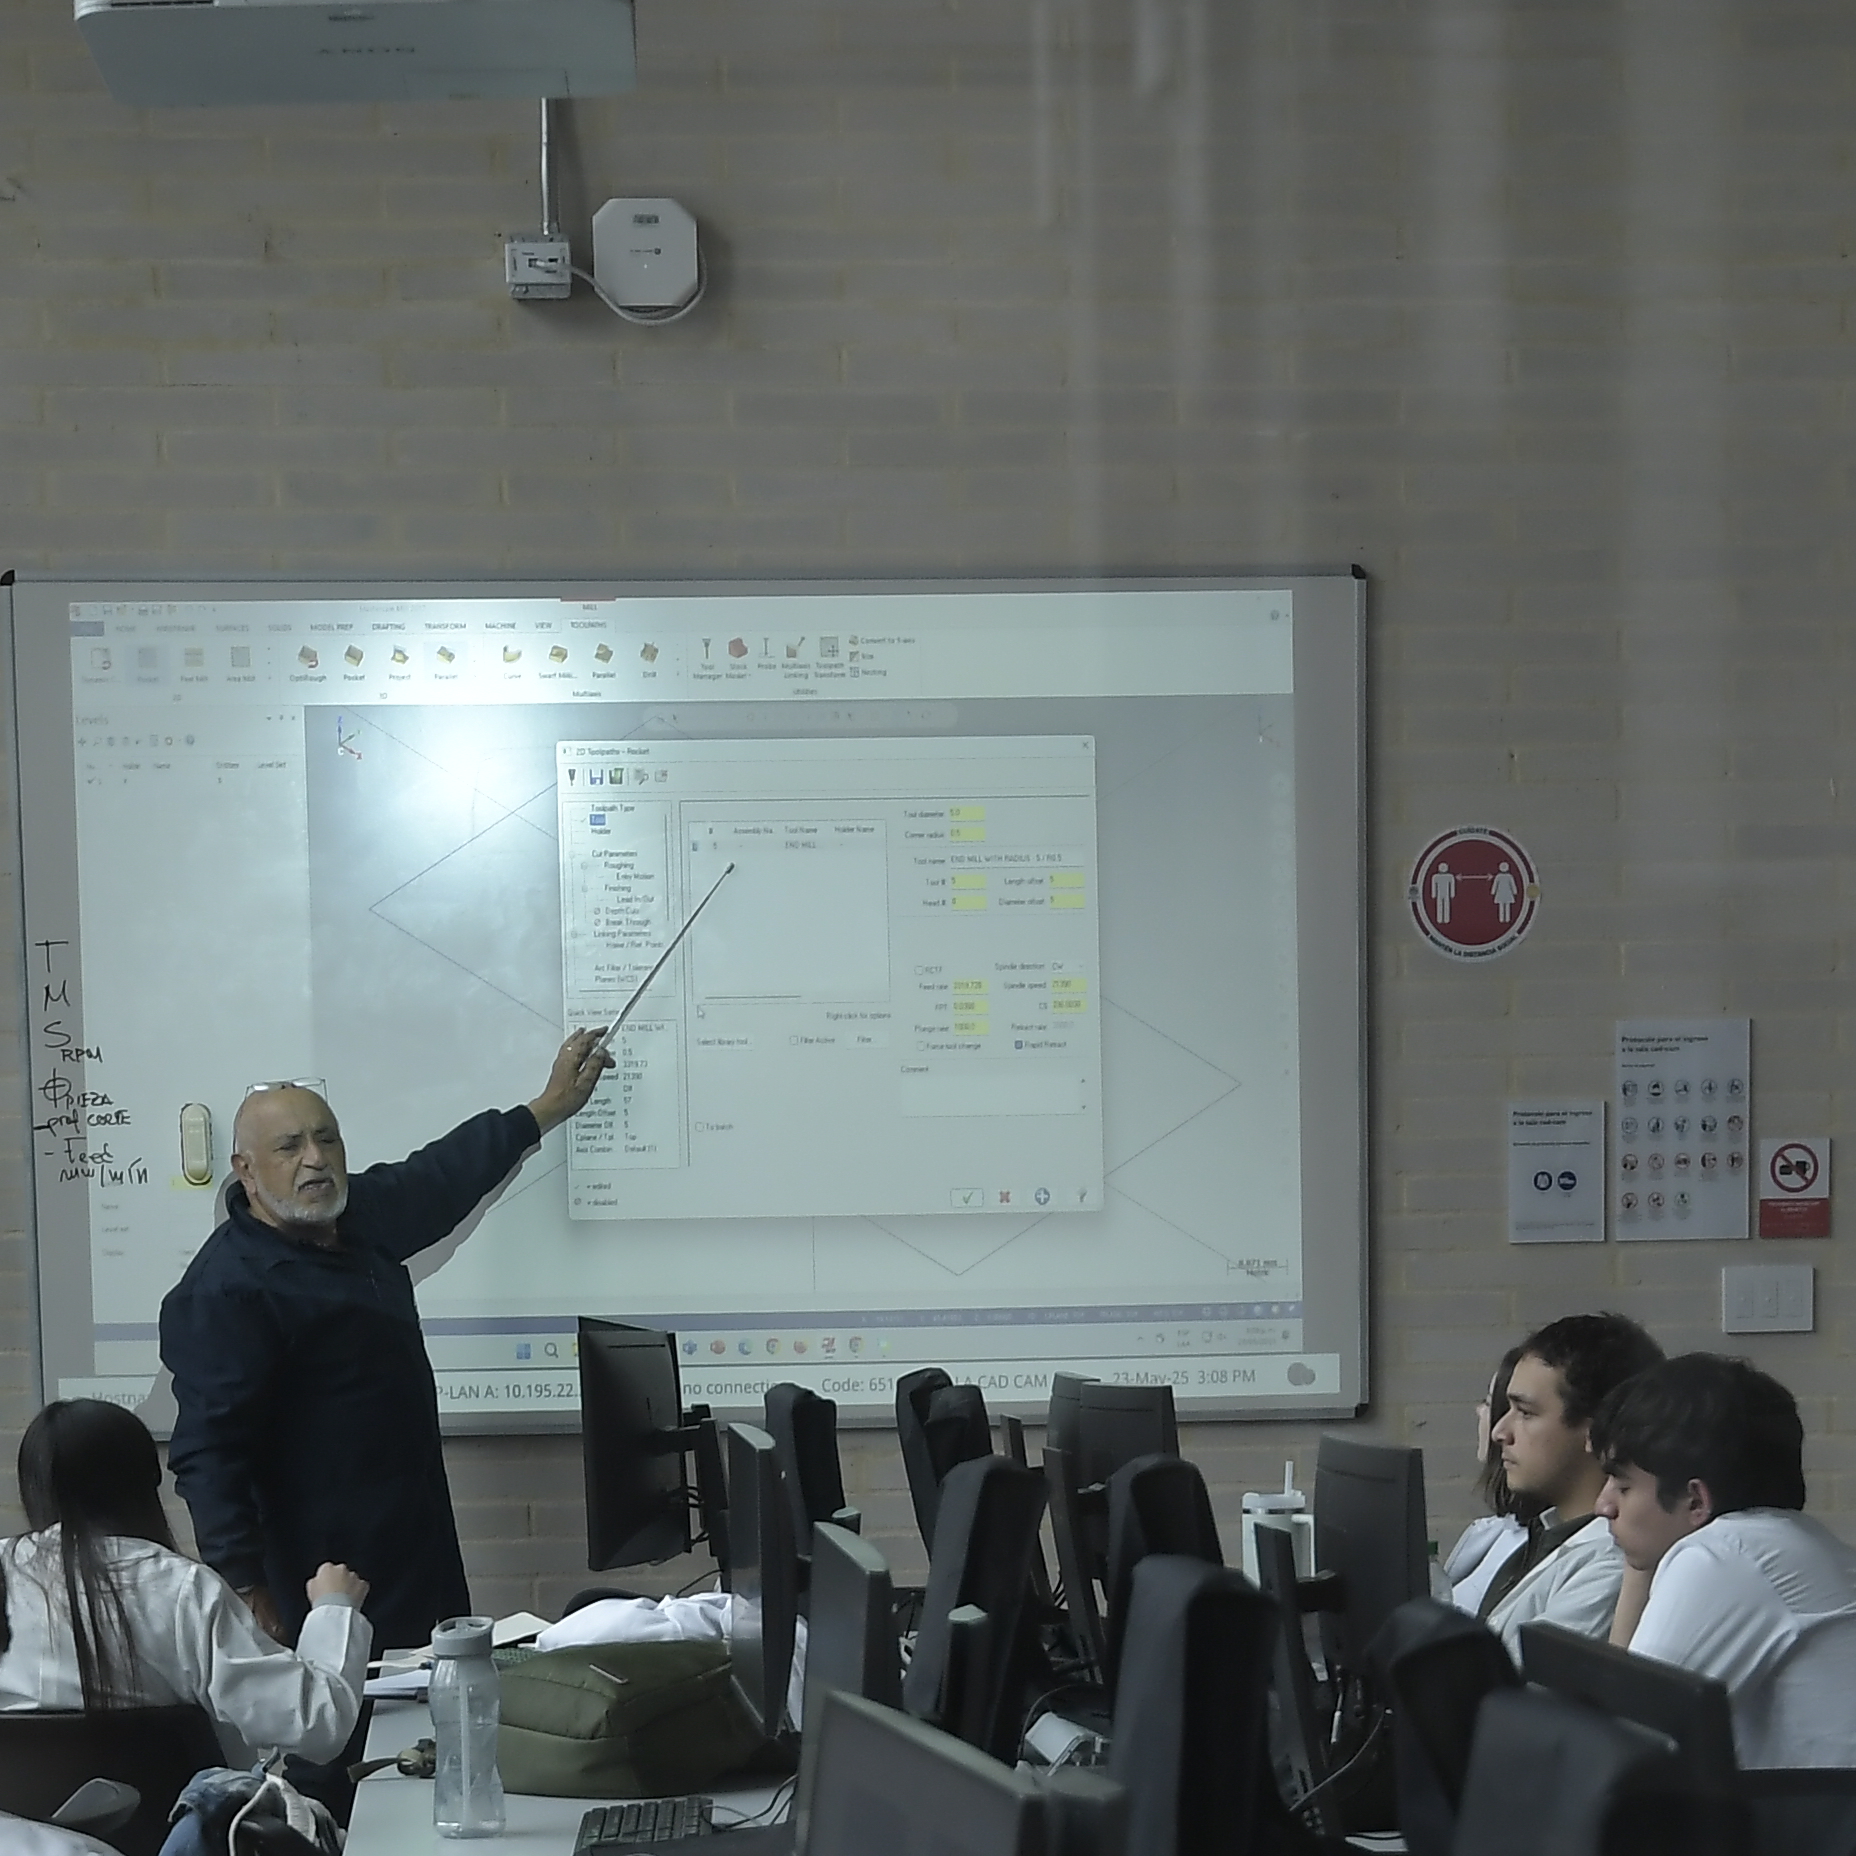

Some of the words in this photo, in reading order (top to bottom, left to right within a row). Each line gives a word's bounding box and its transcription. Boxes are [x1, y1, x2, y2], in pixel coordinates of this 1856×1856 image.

[309, 623, 335, 631] MODEL
[336, 623, 355, 631] PREP
[371, 622, 406, 631] DRAFTING
[424, 622, 467, 630] TRANSFORM
[484, 622, 517, 630] MACHINE
[535, 621, 553, 630] VIEW
[570, 621, 608, 629] TOOLPATHS
[343, 674, 366, 682] Pocket
[591, 672, 617, 680] Parallel
[576, 748, 586, 756] 2D
[587, 747, 621, 757] Toolpaths
[626, 747, 650, 755] Pocket
[591, 804, 619, 813] Toolpath
[619, 804, 635, 812] Type
[591, 828, 612, 836] Holder
[733, 827, 761, 836] Assembly
[784, 826, 798, 834] Tool
[800, 826, 818, 834] Name
[834, 826, 855, 834] Holder
[856, 826, 875, 834] Name
[904, 831, 925, 839] Corner
[785, 841, 800, 849] END
[603, 850, 638, 858] Parameters
[951, 855, 965, 863] END
[1004, 854, 1030, 862] RADIUS
[604, 861, 635, 870] Roughing
[616, 873, 632, 881] Entry
[1004, 878, 1026, 886] Length
[604, 884, 632, 893] Finishing
[998, 898, 1026, 906] Diameter
[605, 907, 625, 916] Depth
[605, 918, 623, 926] Break
[624, 918, 652, 927] Through
[593, 930, 616, 938] Linking
[617, 930, 652, 938] Parameters
[35, 939, 70, 973] T
[1463, 948, 1497, 957] DISTANCIA
[994, 962, 1017, 971] Spindle
[595, 975, 616, 983] Planes
[1004, 981, 1026, 990] Spindle
[43, 979, 71, 1012] M
[568, 1008, 587, 1017] Quick
[914, 1025, 935, 1033] Plunge
[43, 1020, 72, 1048] S
[815, 1036, 836, 1044] Active
[1025, 1041, 1043, 1050] Rapid
[61, 1046, 103, 1063] RPM
[576, 1121, 603, 1130] Diameter
[576, 1133, 597, 1142] Cplane
[63, 1136, 114, 1164] Feed
[978, 1375, 1010, 1389] CAD
[1014, 1374, 1048, 1389] CAM
[1113, 1370, 1189, 1385] 23-May-25
[1197, 1369, 1228, 1384] 3:08
[1232, 1369, 1256, 1383] PM
[683, 1383, 702, 1395] no
[706, 1379, 776, 1394] connecti
[821, 1377, 864, 1393] Code:
[869, 1377, 894, 1392] 651
[436, 1384, 480, 1400] P-LAN
[484, 1384, 499, 1399] A:
[505, 1382, 579, 1399] 10.195.22.
[92, 1391, 145, 1405] Hostna
